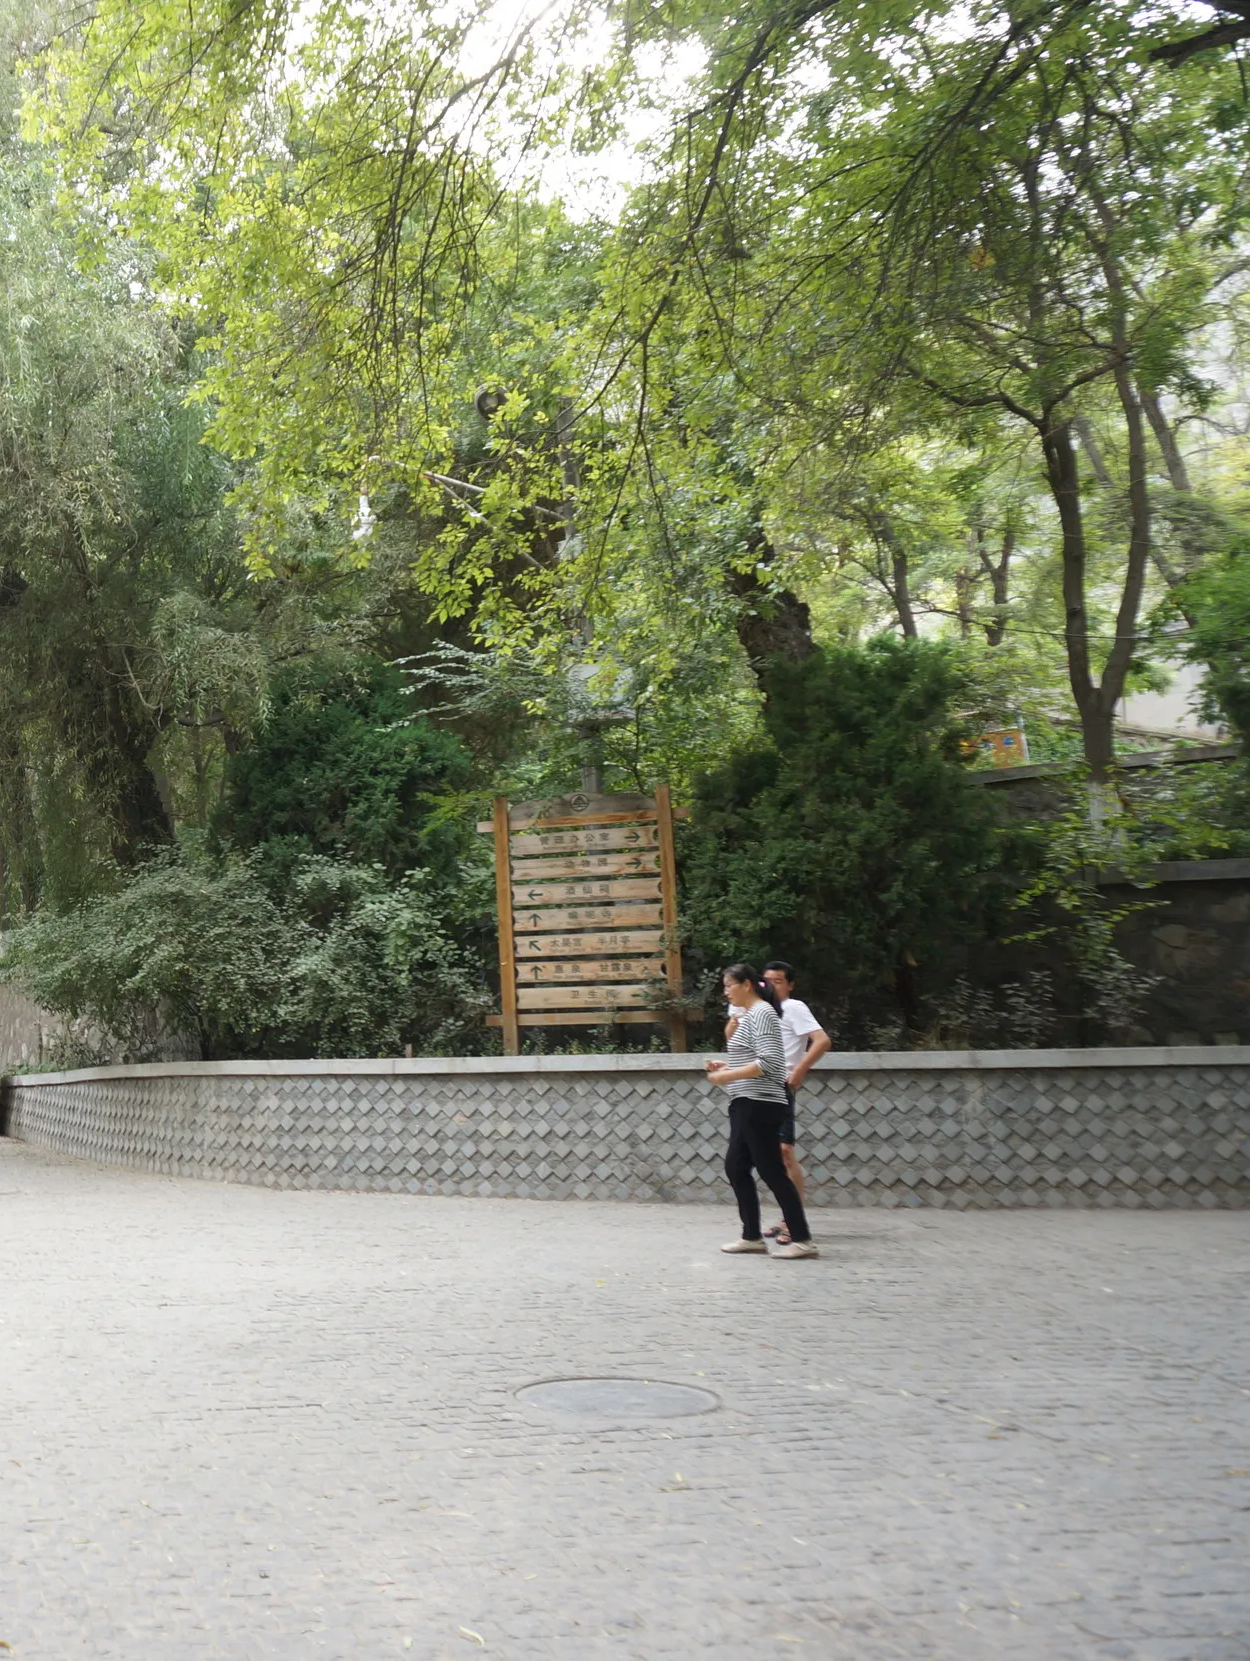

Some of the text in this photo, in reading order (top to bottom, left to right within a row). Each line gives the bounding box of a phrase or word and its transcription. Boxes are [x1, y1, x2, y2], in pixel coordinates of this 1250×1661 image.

[539, 832, 610, 846] 管理办公室
[598, 962, 632, 973] 甘露泉
